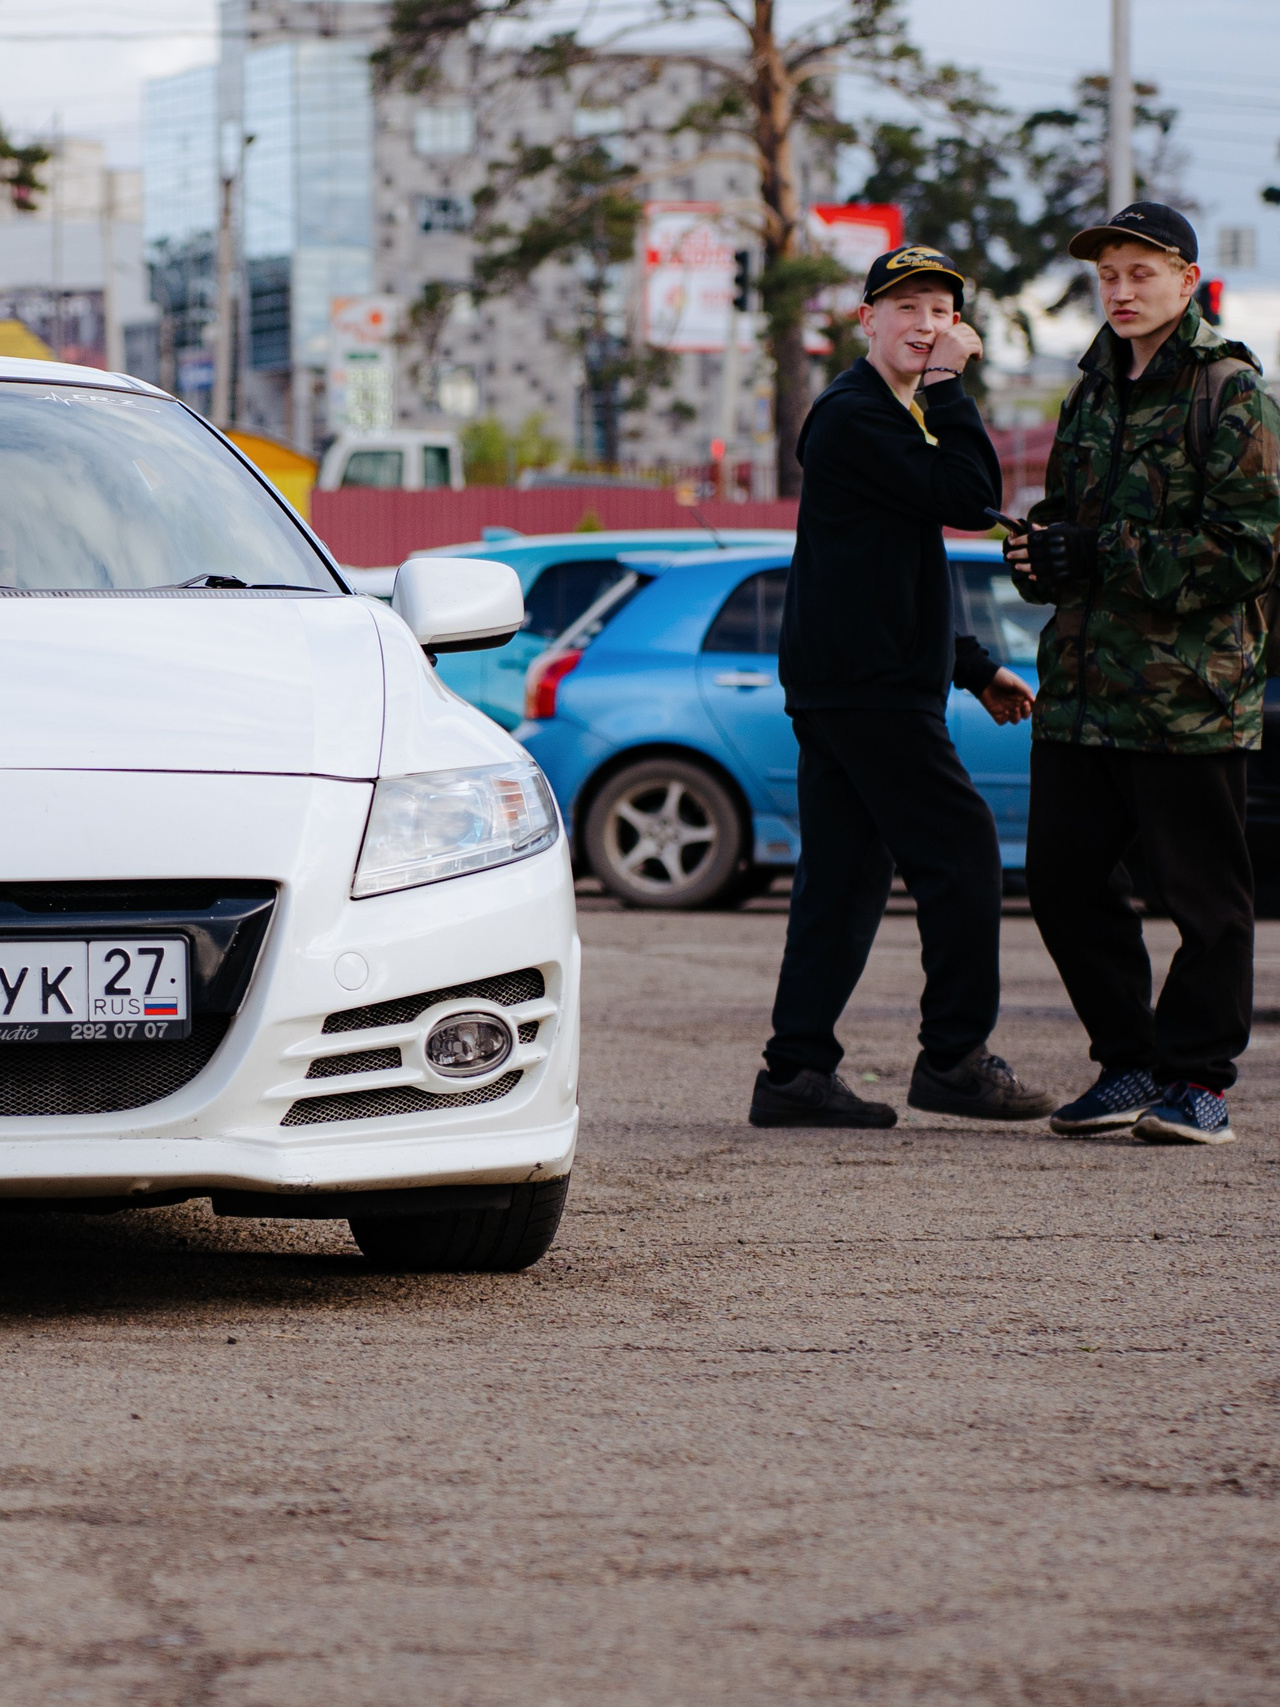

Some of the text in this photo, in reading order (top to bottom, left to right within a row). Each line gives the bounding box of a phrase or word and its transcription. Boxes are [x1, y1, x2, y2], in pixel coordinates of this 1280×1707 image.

[72, 393, 137, 407] CR-Z
[103, 947, 165, 996] 27
[93, 998, 141, 1016] RUS
[70, 1023, 107, 1040] 292
[113, 1023, 138, 1039] 07
[144, 1022, 169, 1039] 07
